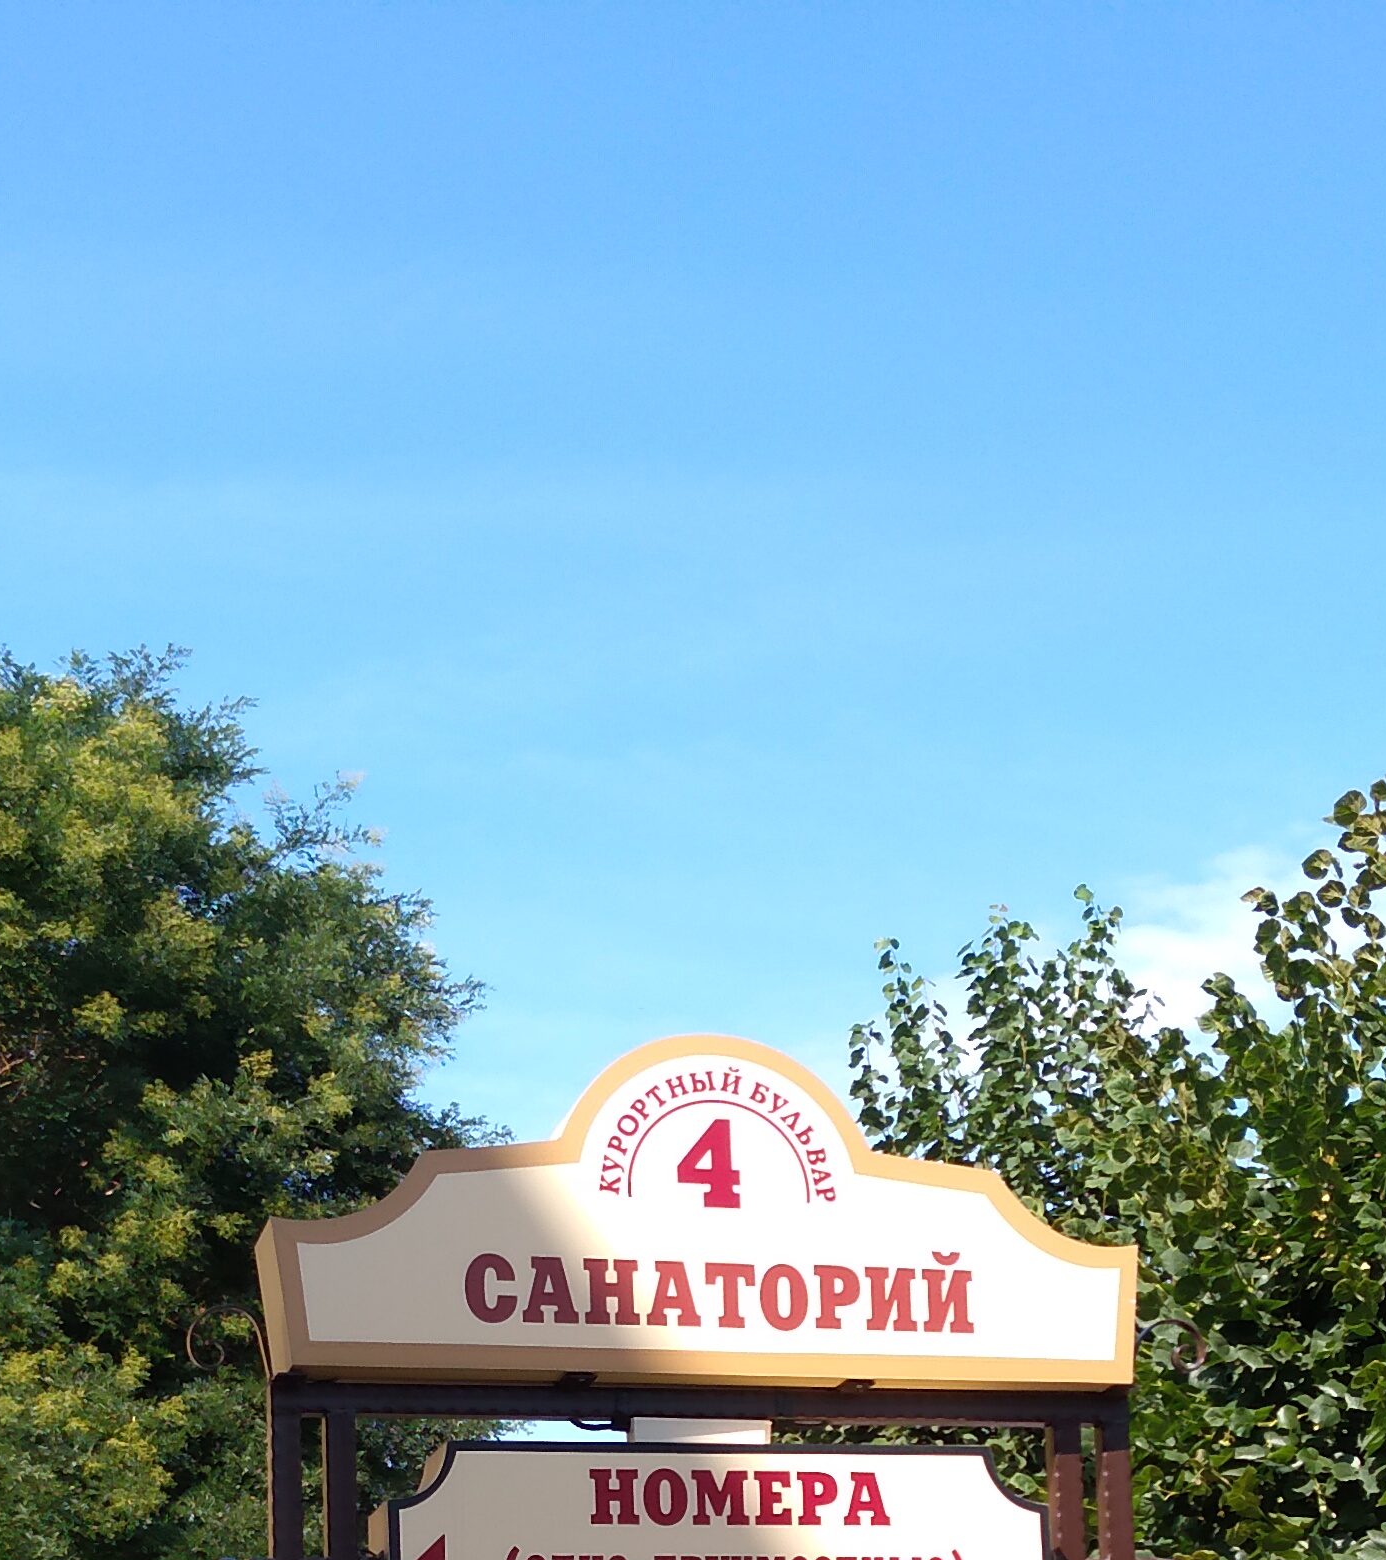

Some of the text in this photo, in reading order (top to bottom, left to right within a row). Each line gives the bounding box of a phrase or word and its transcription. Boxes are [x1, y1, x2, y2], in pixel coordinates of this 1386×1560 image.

[599, 1067, 837, 1203] КУРОРТНЫЙ БУЛЬВАР
[677, 1118, 741, 1209] 4
[465, 1250, 975, 1334] САНАТОРИЙ
[589, 1467, 892, 1527] НОМЕРА
